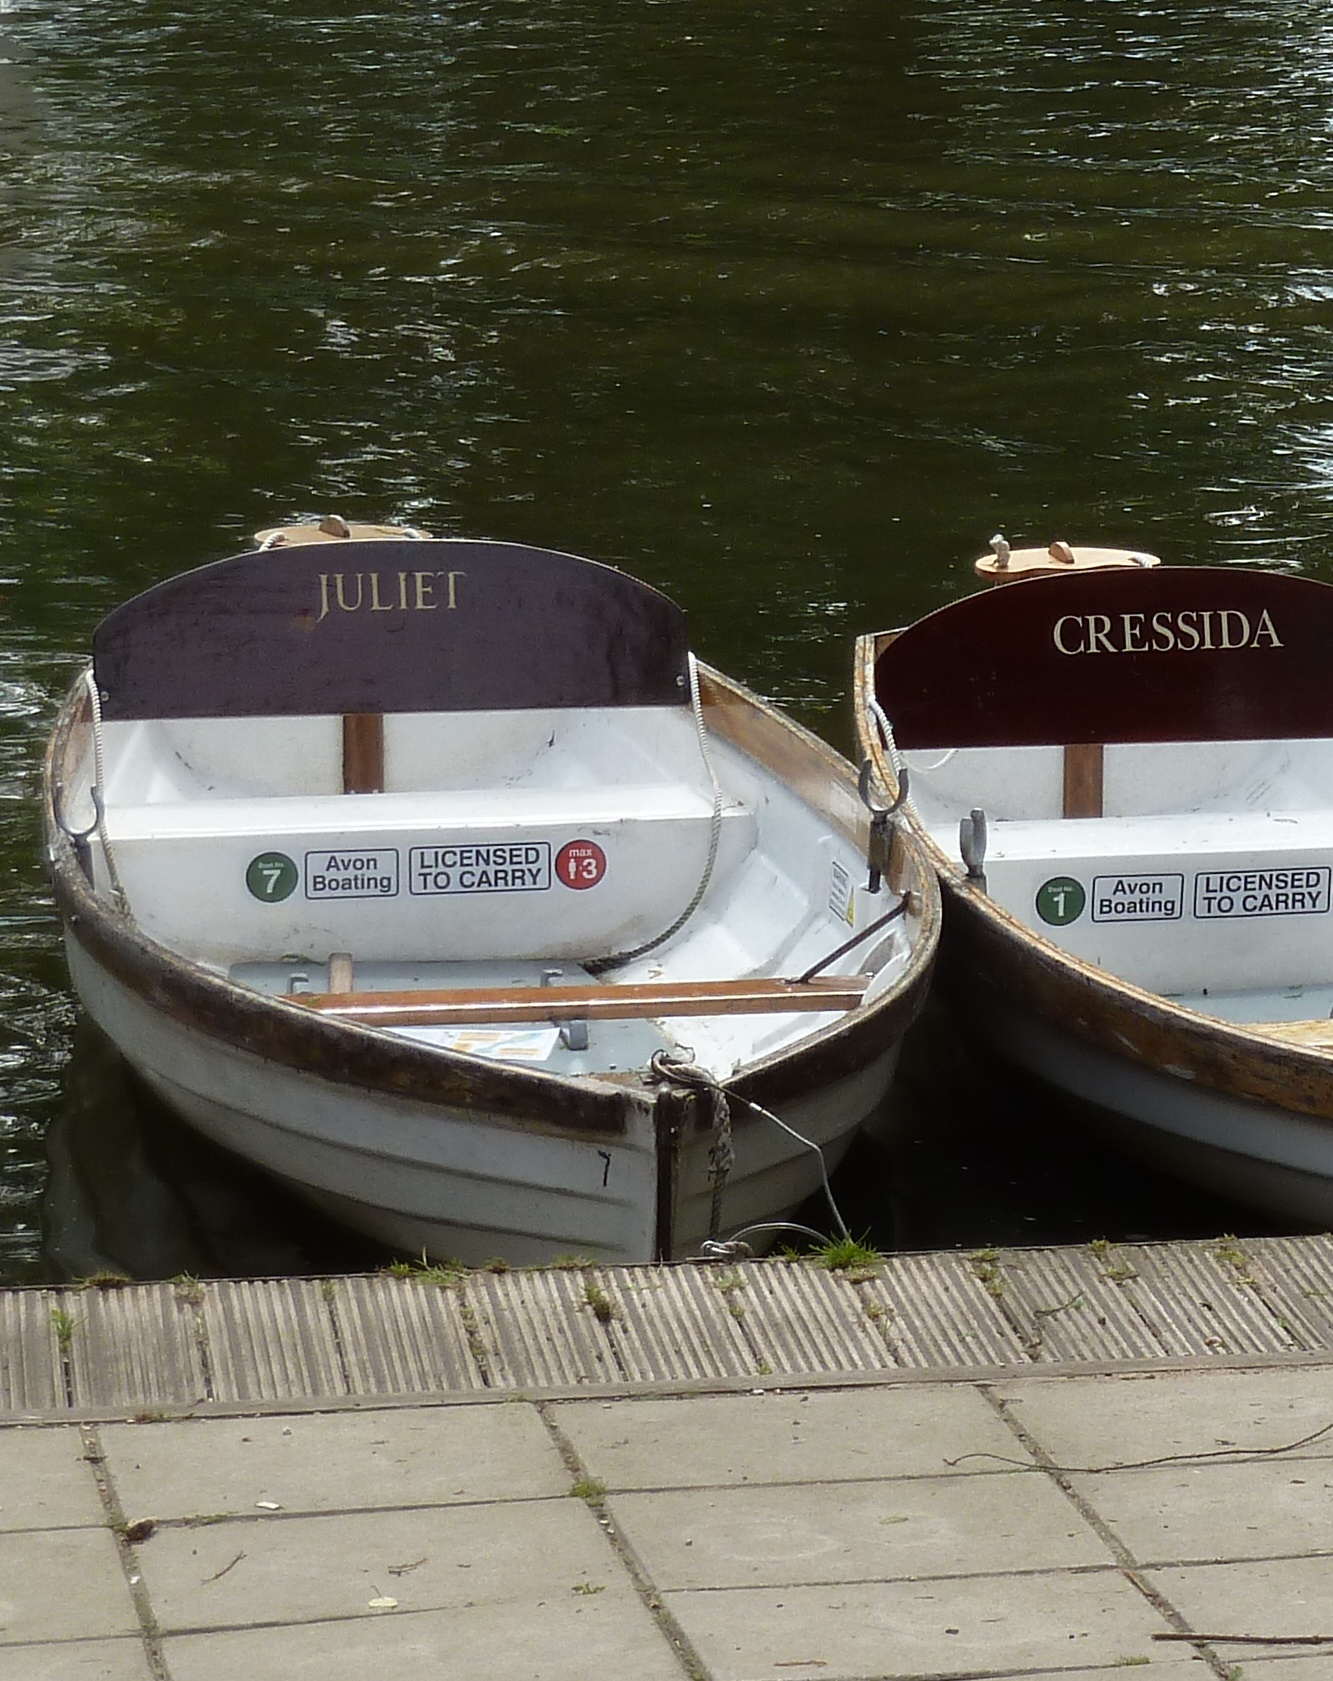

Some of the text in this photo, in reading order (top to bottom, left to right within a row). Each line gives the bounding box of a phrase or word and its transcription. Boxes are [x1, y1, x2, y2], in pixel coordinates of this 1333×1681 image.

[316, 571, 468, 624] JULIET
[1053, 608, 1285, 655] CRESSIDA
[420, 847, 541, 870] LICENSED
[568, 847, 593, 857] max
[325, 855, 378, 872] Avon
[582, 858, 598, 879] 3
[262, 870, 281, 893] 7
[312, 872, 392, 893] Boating
[418, 868, 542, 891] TO CARRY
[1112, 879, 1163, 896] Avon
[1205, 871, 1321, 893] LICENSED
[1053, 893, 1065, 917] 1
[1099, 897, 1176, 916] Boating
[1202, 891, 1323, 914] TO CARRY
